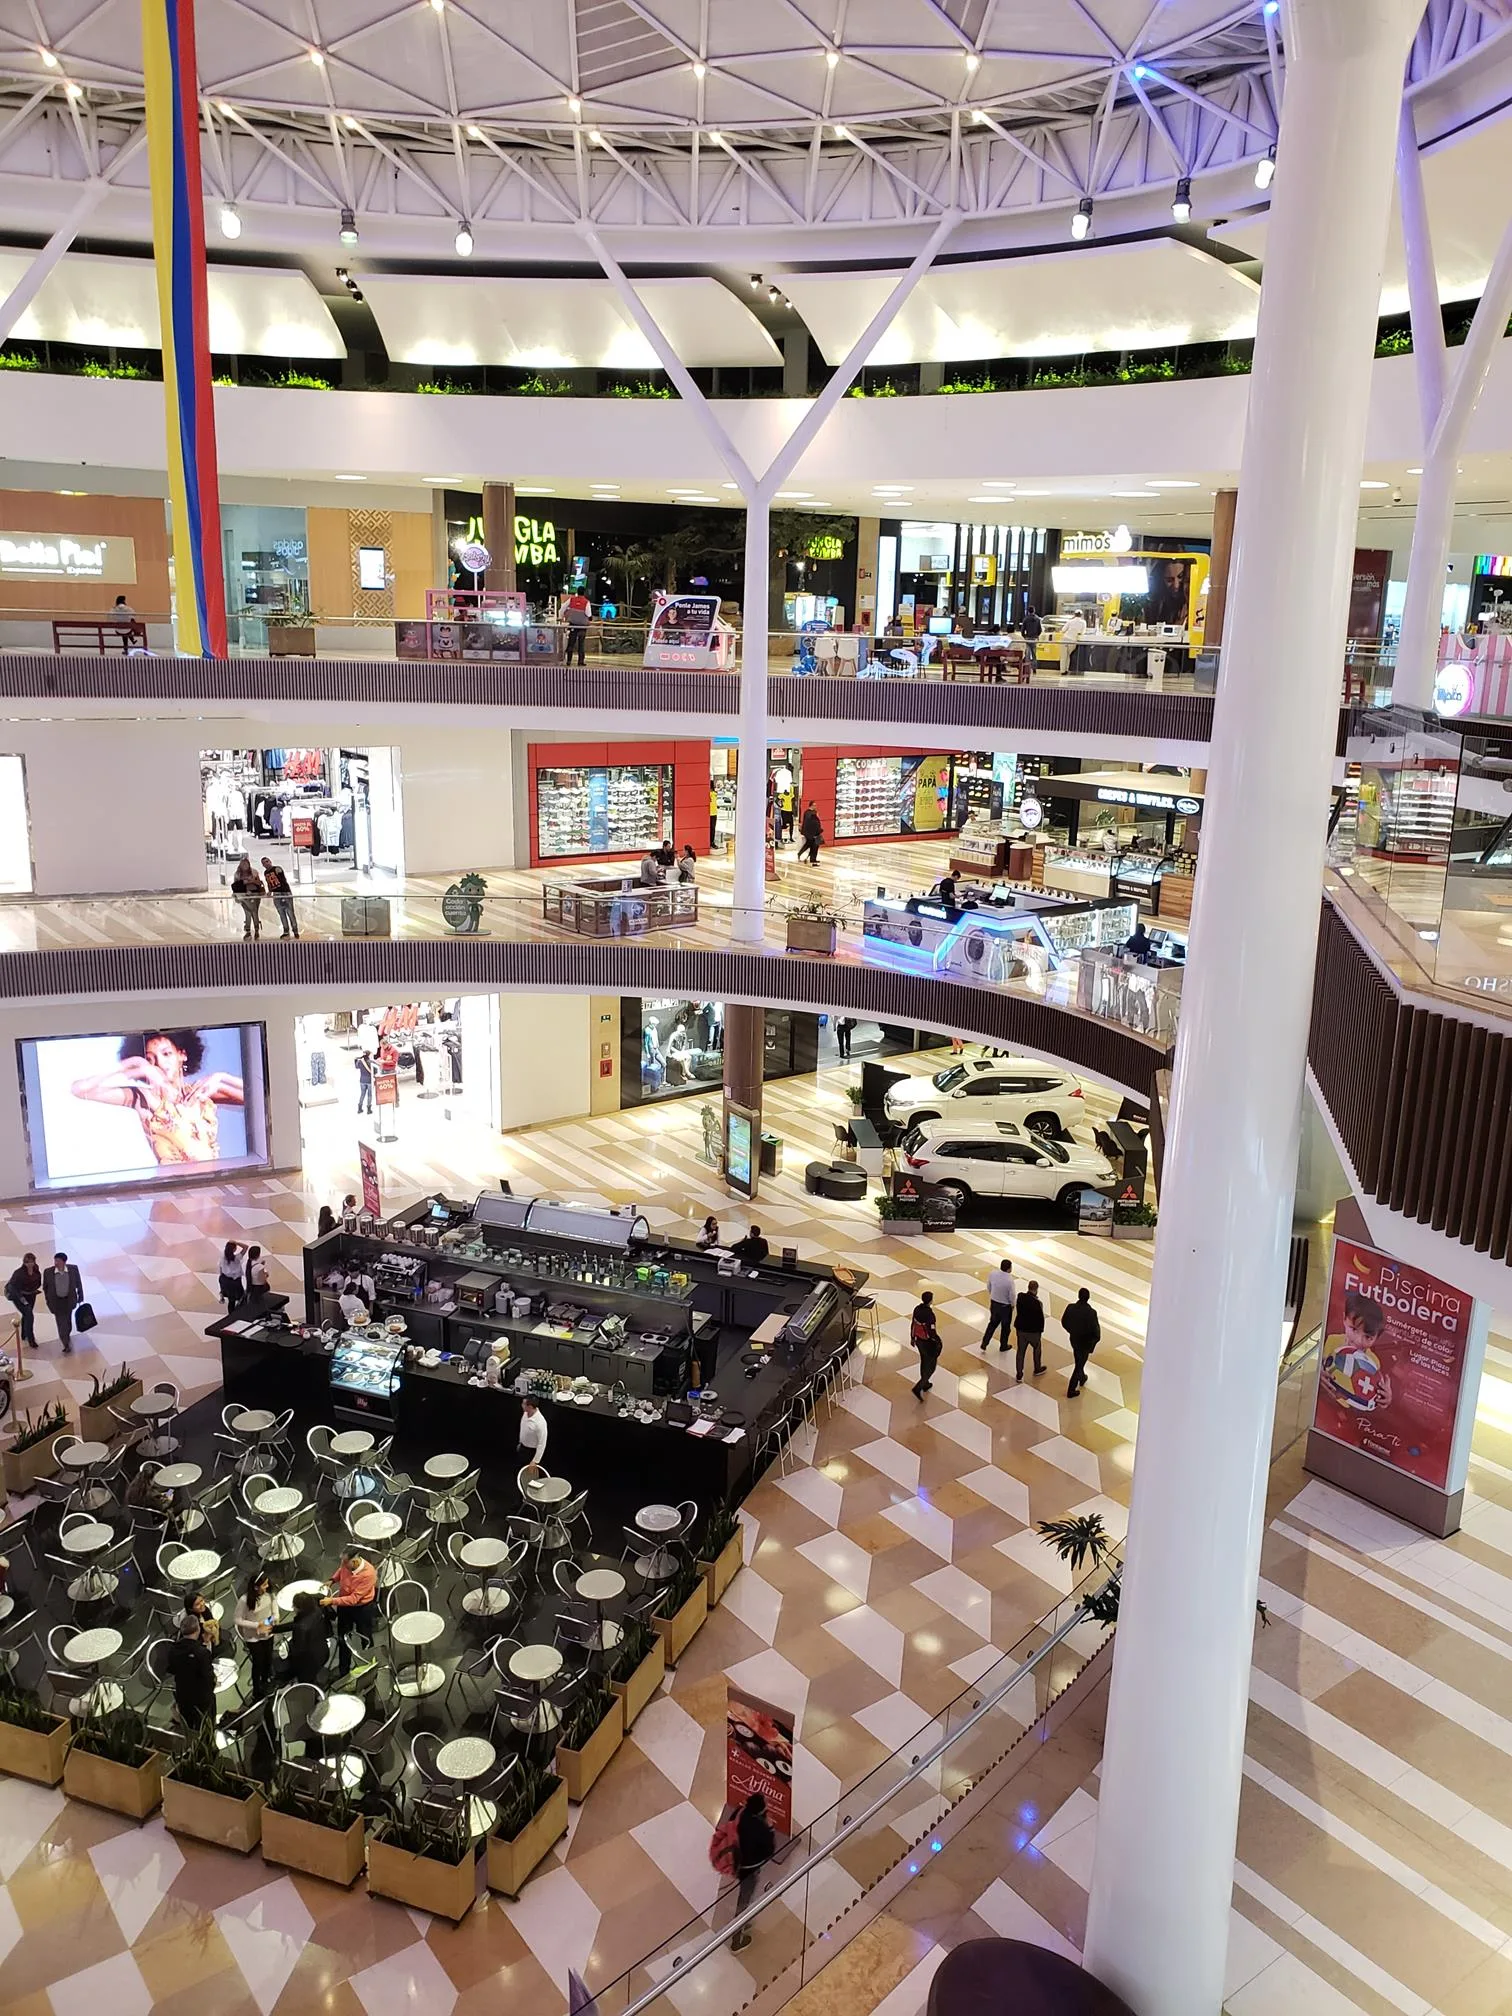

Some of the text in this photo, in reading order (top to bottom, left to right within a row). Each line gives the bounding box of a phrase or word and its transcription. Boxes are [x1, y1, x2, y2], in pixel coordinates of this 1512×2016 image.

[1379, 1267, 1460, 1313] Piscina
[1344, 1272, 1458, 1332] Futbolera
[1386, 1315, 1428, 1337] Sumérgete
[1421, 1337, 1433, 1346] de
[1356, 1417, 1388, 1440] Para
